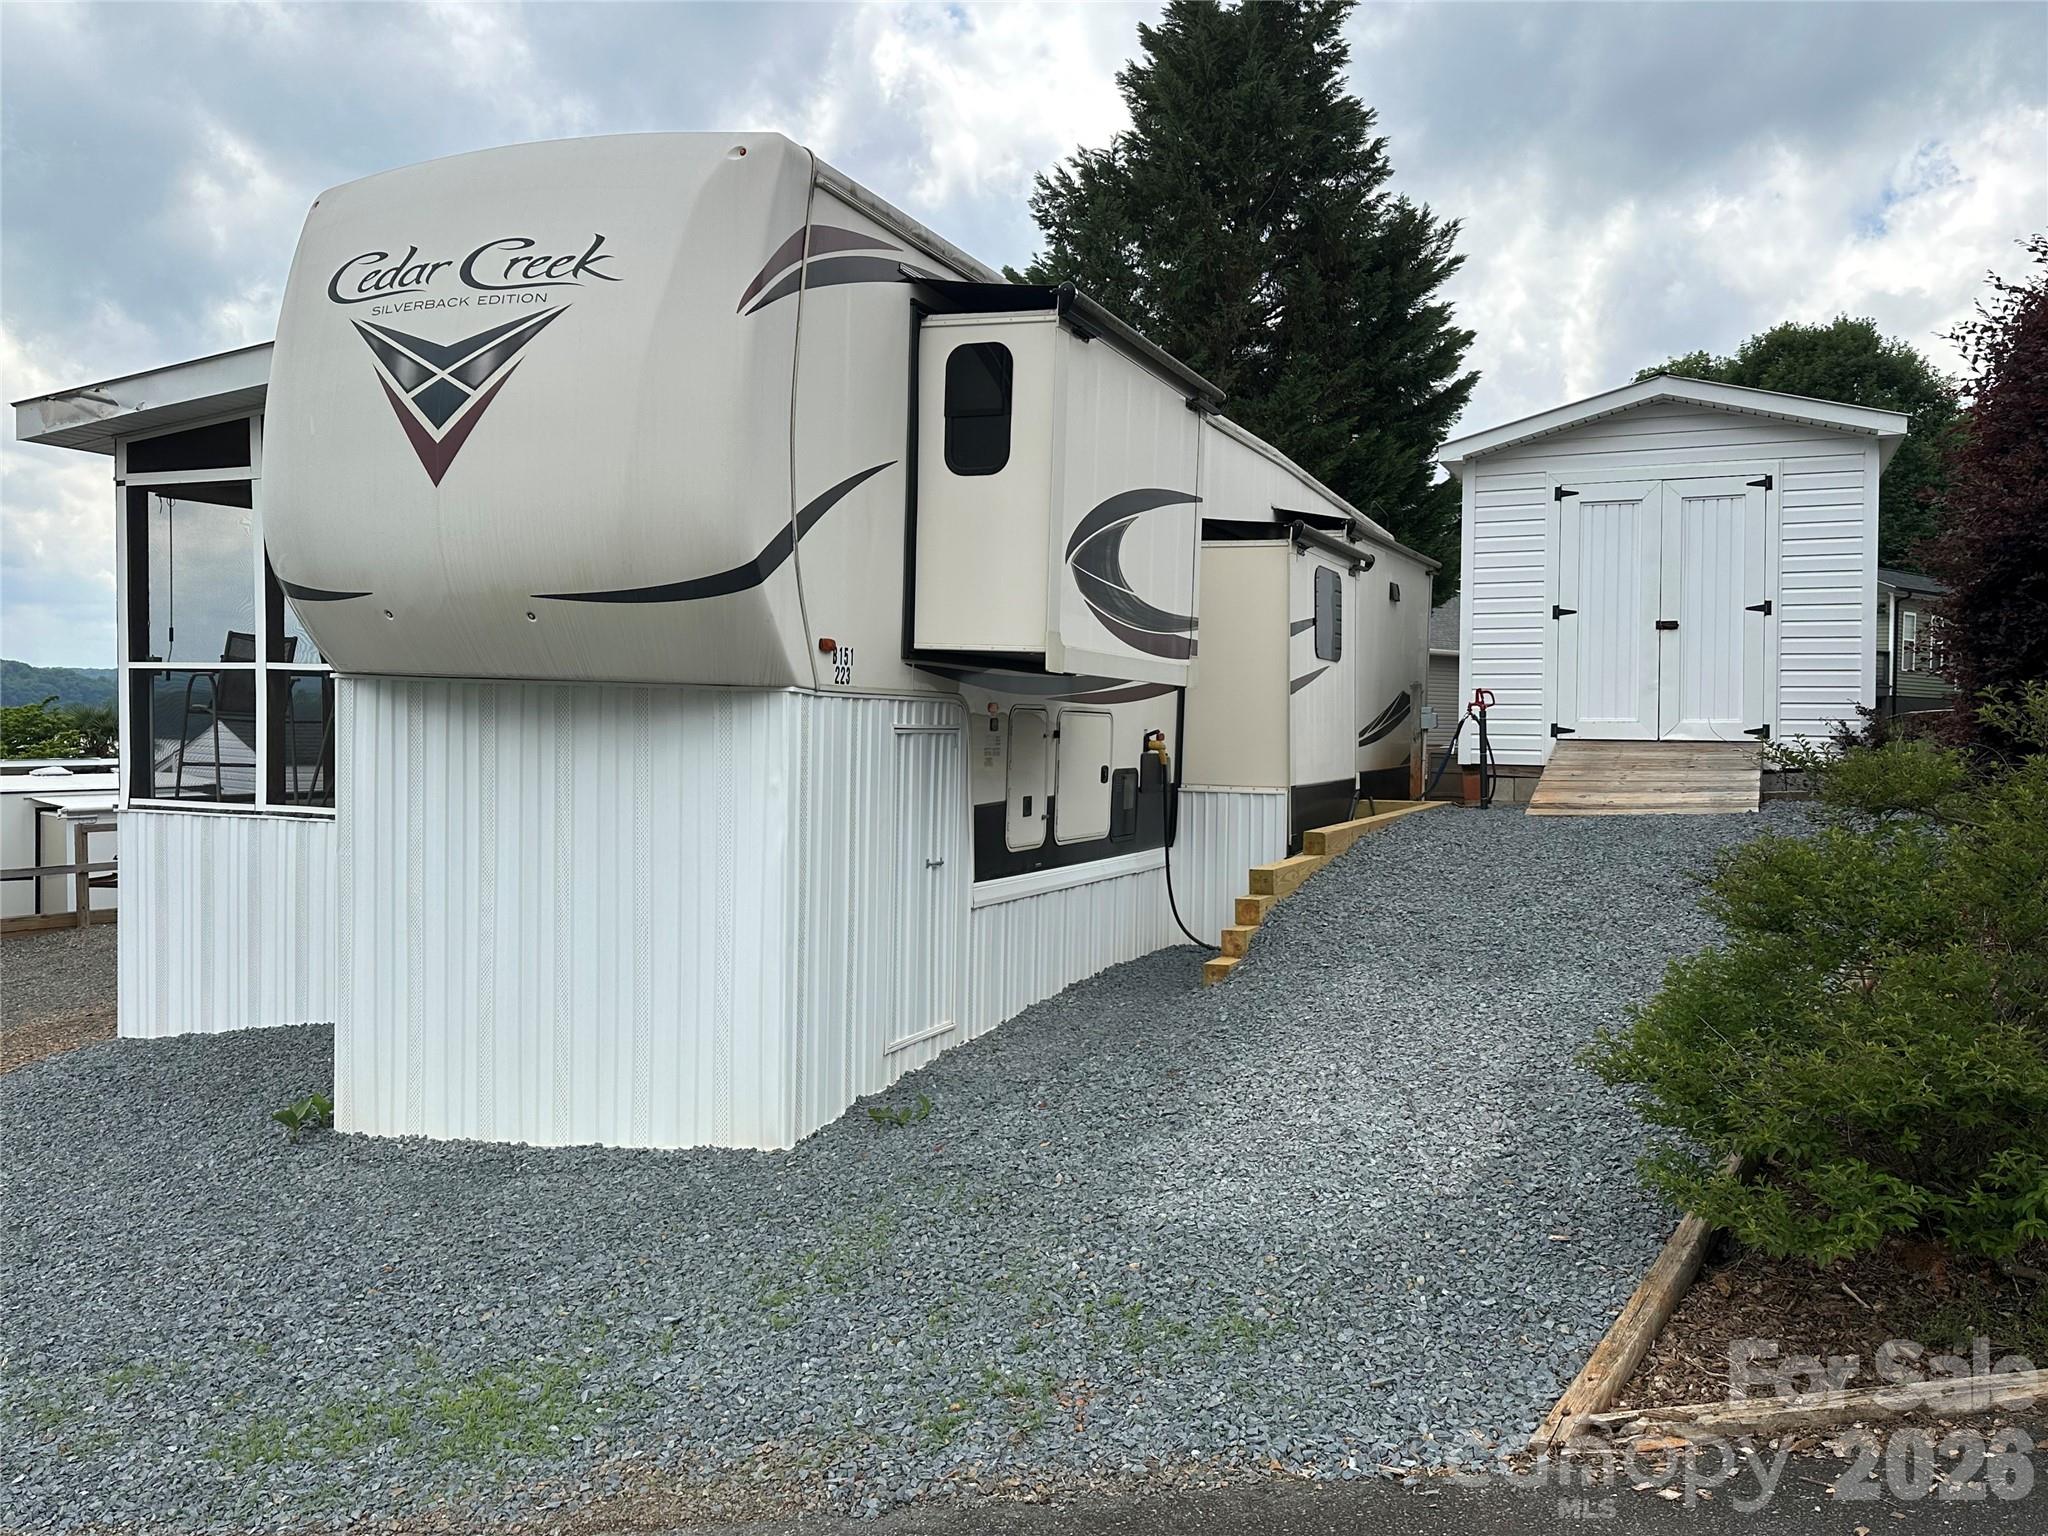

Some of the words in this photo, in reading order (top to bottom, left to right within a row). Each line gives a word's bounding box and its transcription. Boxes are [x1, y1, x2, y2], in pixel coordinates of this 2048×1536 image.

[327, 245, 453, 305] Cedar
[458, 233, 625, 291] Creek
[371, 296, 470, 316] SILVERBACK
[477, 292, 549, 306] EDITION
[834, 665, 851, 685] 223
